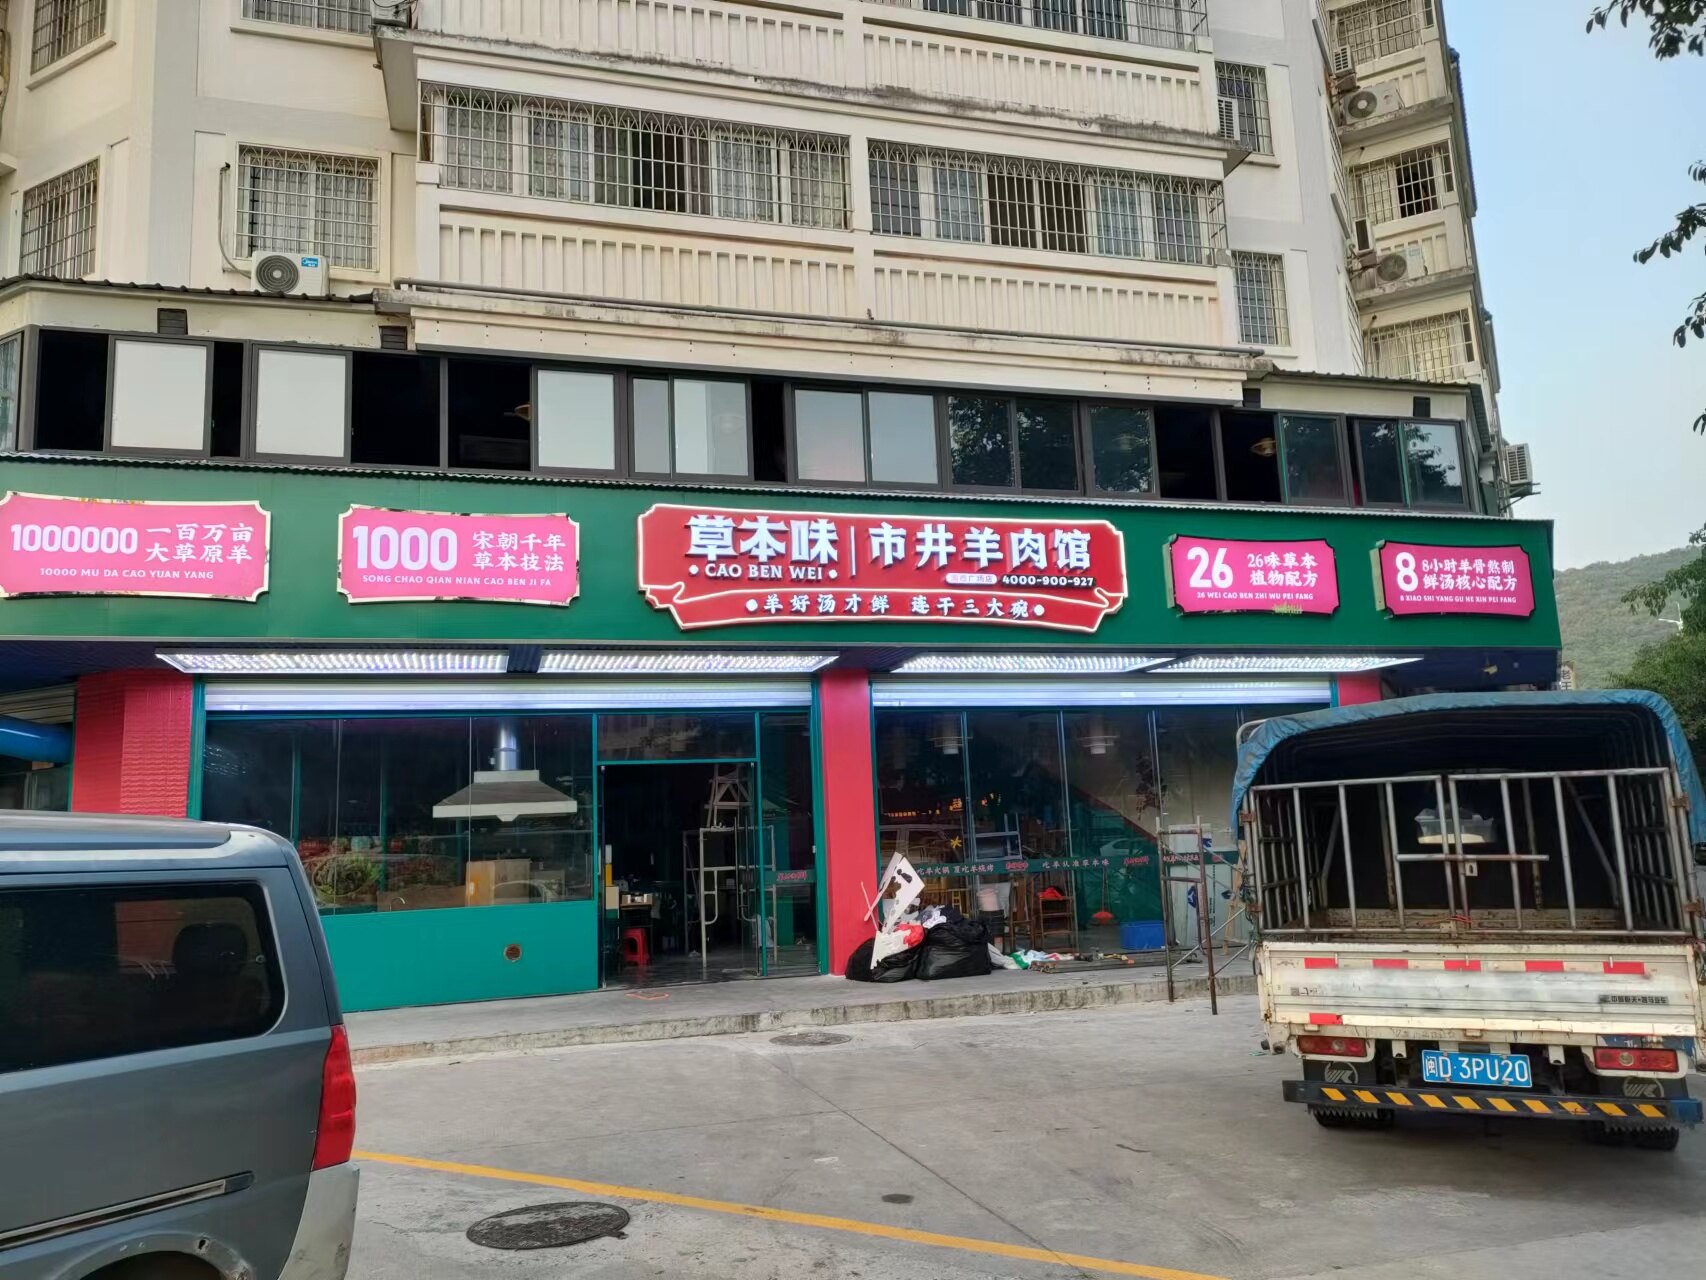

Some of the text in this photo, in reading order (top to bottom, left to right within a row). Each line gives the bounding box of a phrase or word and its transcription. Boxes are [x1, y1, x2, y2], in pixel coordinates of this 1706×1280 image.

[11, 524, 138, 554] 1000000
[146, 523, 254, 542] 一百万亩
[472, 530, 566, 552] 宋朝千年
[684, 514, 1091, 570] 草本味 市井羊肉馆
[145, 543, 252, 564] 大草原羊
[353, 525, 458, 571] 1000
[472, 551, 564, 572] 草本技法
[1187, 546, 1234, 589] 26
[1247, 552, 1319, 569] 26味草本
[40, 567, 214, 580] 10000 MU DA CAO YUAN YANG
[362, 574, 551, 586] SONG CHAO QIAN NIAN CAO BEN JI FA
[705, 563, 823, 581] CAO BEN WEI
[1002, 575, 1093, 586] 4000-900-927
[1250, 570, 1319, 587] 植物配方
[1395, 552, 1418, 592] 8
[1423, 574, 1518, 591] 鲜汤核心配方
[763, 593, 889, 614] 羊好汤才鲜
